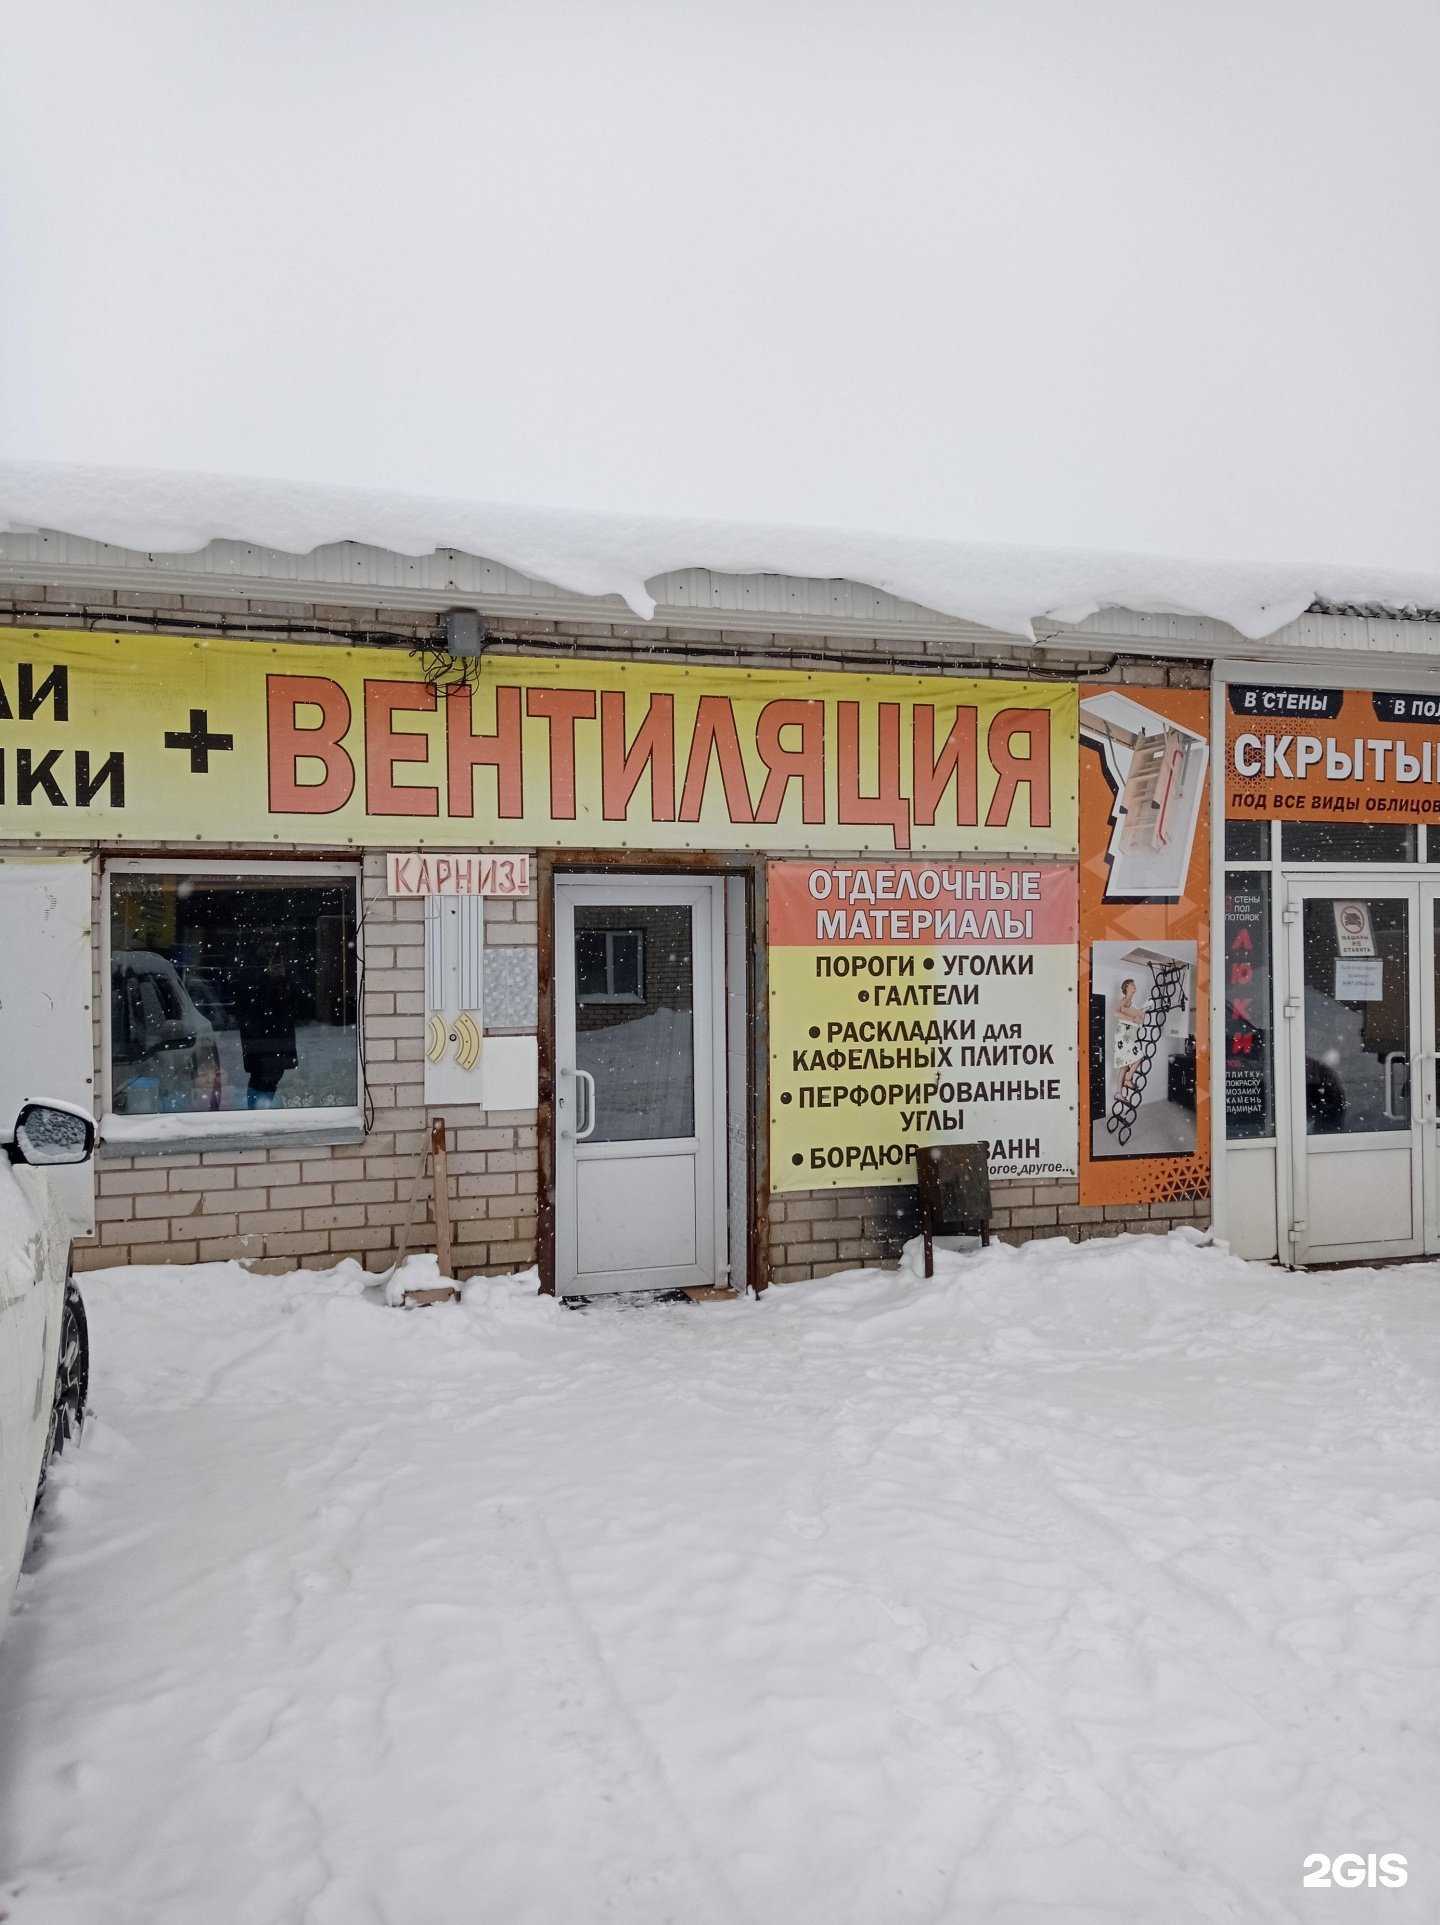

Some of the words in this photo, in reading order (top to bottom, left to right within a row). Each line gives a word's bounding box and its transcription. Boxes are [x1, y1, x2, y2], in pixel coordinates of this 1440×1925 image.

[1244, 692, 1256, 707] В
[1263, 692, 1328, 711] СТЕНЫ
[1394, 700, 1405, 715] В
[265, 674, 1051, 850] ВЕНТИЛЯЦИЯ
[1234, 733, 1440, 784] СКРЫТЫ
[0, 748, 125, 809] КИ
[1231, 794, 1267, 810] ПОД
[1273, 795, 1306, 809] ВСЕ
[1311, 796, 1360, 812] ВИДЫ
[395, 857, 529, 894] КАРНИЗ!
[808, 869, 1041, 905] ОТДЕЛОЧНЫЕ
[815, 909, 1033, 939] МАТЕРИАЛЫ
[816, 955, 914, 977] ПОРОГИ
[942, 954, 1033, 976] УГОЛКИ
[874, 984, 979, 1006] ГАЛТЕЛИ
[827, 1019, 976, 1044] РАСКЛАДКИ
[982, 1023, 1022, 1042] для
[793, 1046, 953, 1071] КАФЕЛЬНЫХ
[961, 1044, 1054, 1067] ПЛИТОК
[798, 1079, 1061, 1108] ПЕРФОРИРОВАННЫЕ
[900, 1109, 964, 1132] УГЛЫ
[987, 1164, 1017, 1175] огое
